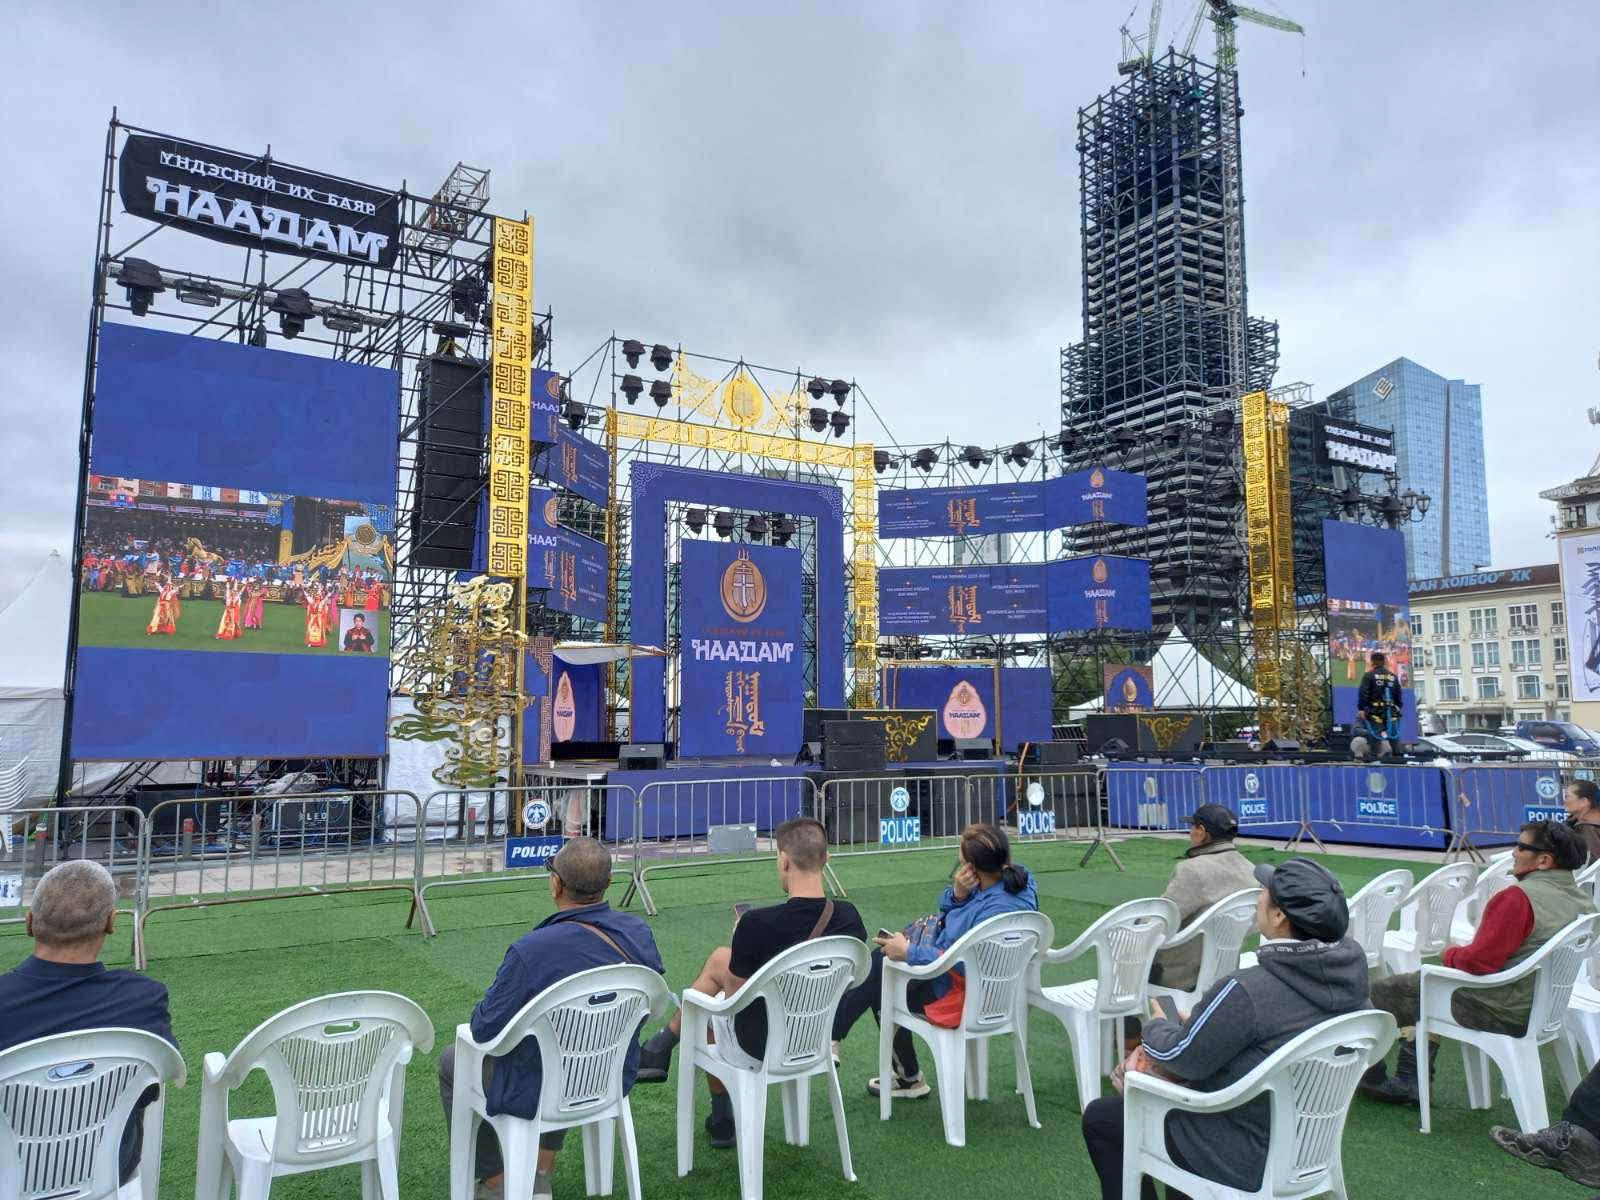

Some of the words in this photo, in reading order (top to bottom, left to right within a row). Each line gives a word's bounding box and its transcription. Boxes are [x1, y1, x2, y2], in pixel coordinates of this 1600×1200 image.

[160, 151, 275, 192] ҮНДЭСНИЙ
[289, 184, 314, 201] ИХ
[328, 193, 376, 216] БАЯР
[146, 176, 389, 263] НААДАМ
[1510, 569, 1533, 582] ХК
[691, 639, 794, 663] НААДАМ
[1241, 803, 1266, 815] POLICE
[1360, 802, 1395, 815] POLICE
[881, 820, 920, 843] POLICE
[1019, 811, 1056, 834] POLICE
[511, 844, 559, 859] POLICE
